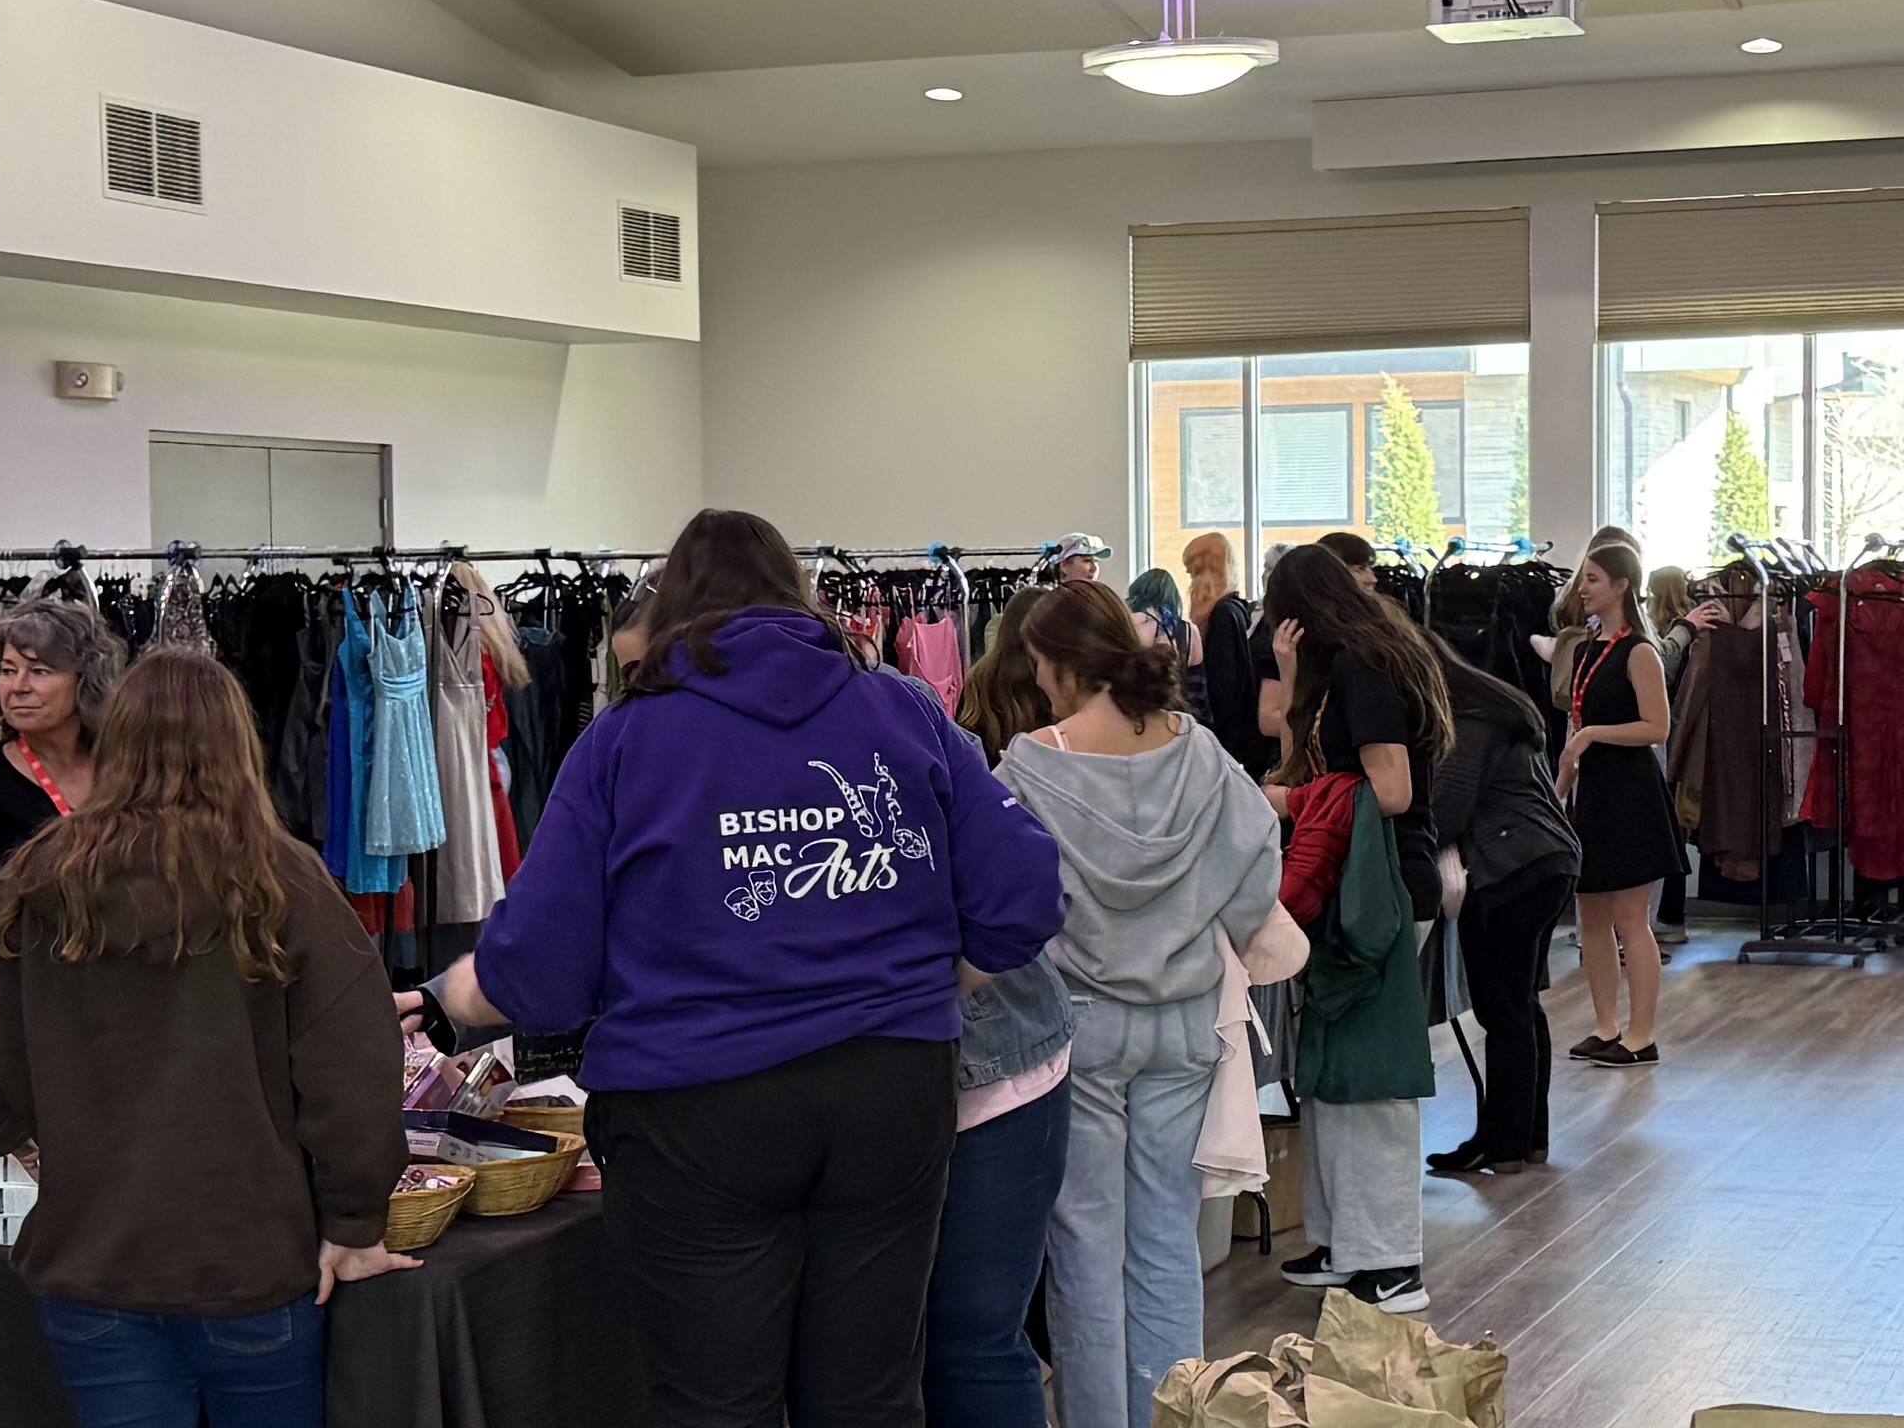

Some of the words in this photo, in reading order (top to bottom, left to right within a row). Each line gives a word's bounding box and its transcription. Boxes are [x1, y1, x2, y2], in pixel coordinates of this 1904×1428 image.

[719, 807, 845, 836] BISHOP
[723, 843, 792, 870] MAC
[784, 837, 898, 900] Arts
